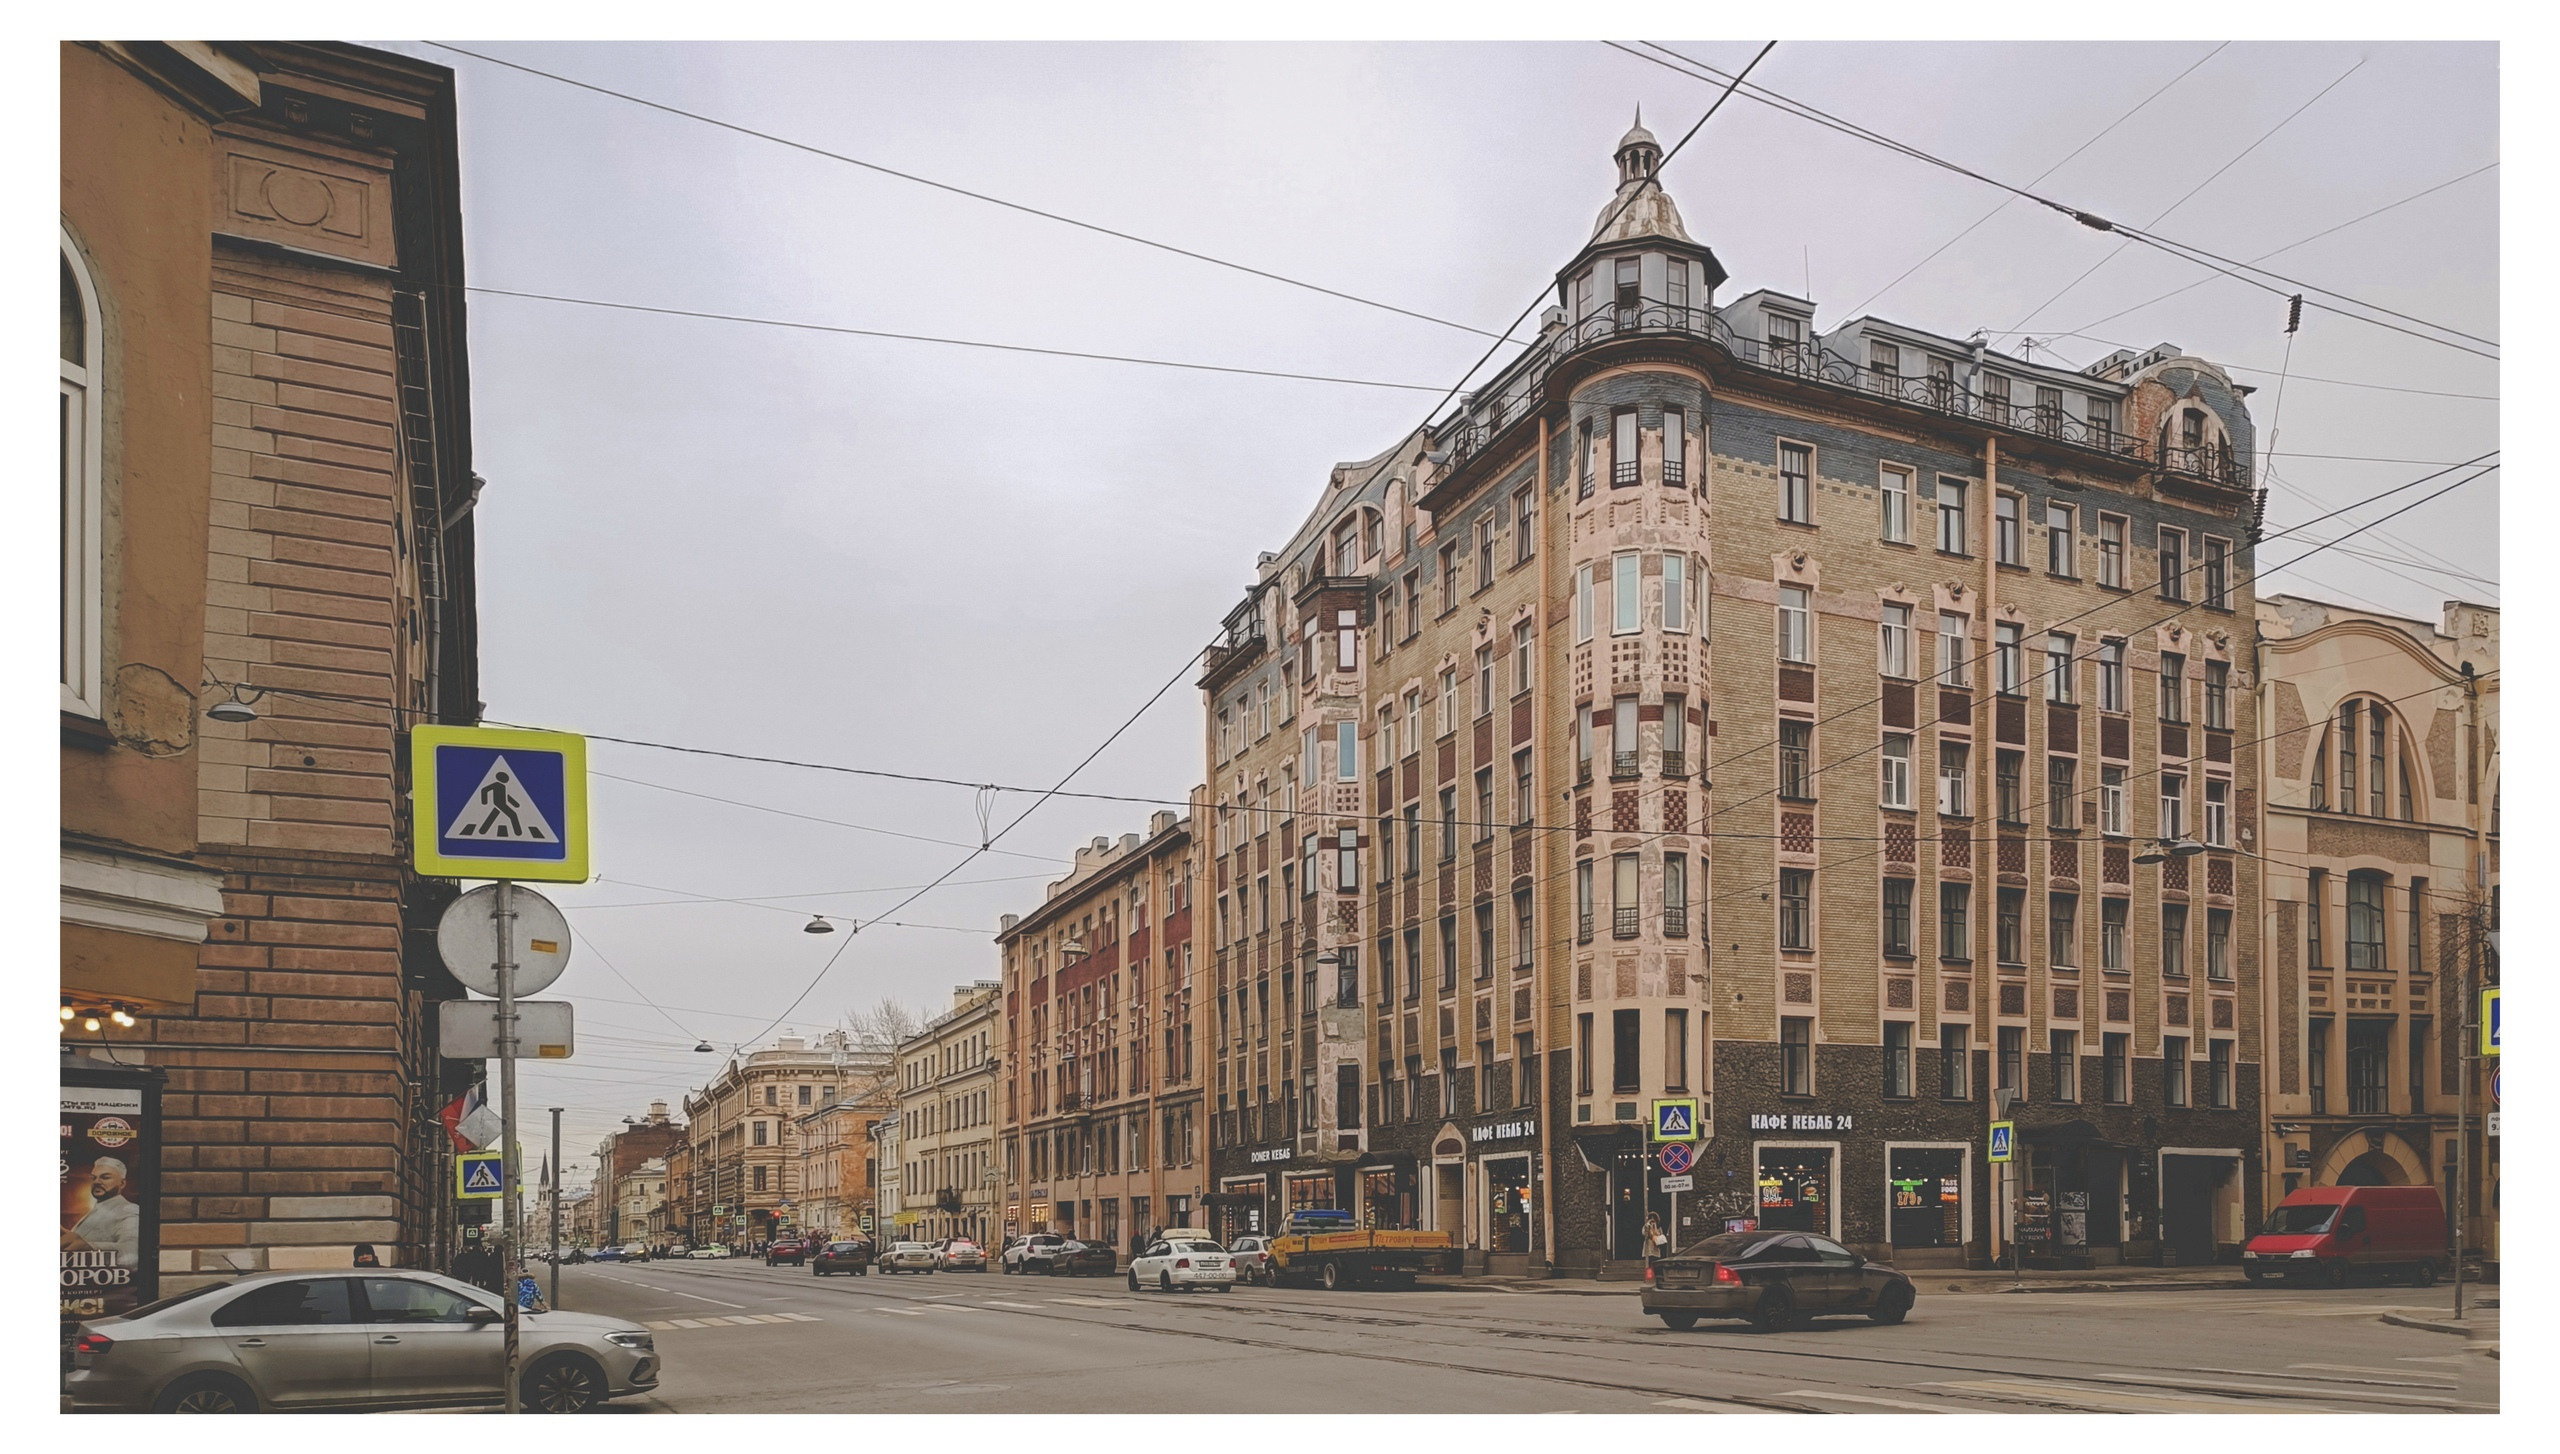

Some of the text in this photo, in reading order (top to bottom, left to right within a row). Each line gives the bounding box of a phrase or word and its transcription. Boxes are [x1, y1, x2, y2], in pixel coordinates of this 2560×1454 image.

[1751, 1114, 1853, 1130] КАФЕ КЕБАБ 24
[1472, 1120, 1535, 1142] КАФЕ КЕБАБ 24
[1251, 1148, 1291, 1163] DONER КЕБАБ
